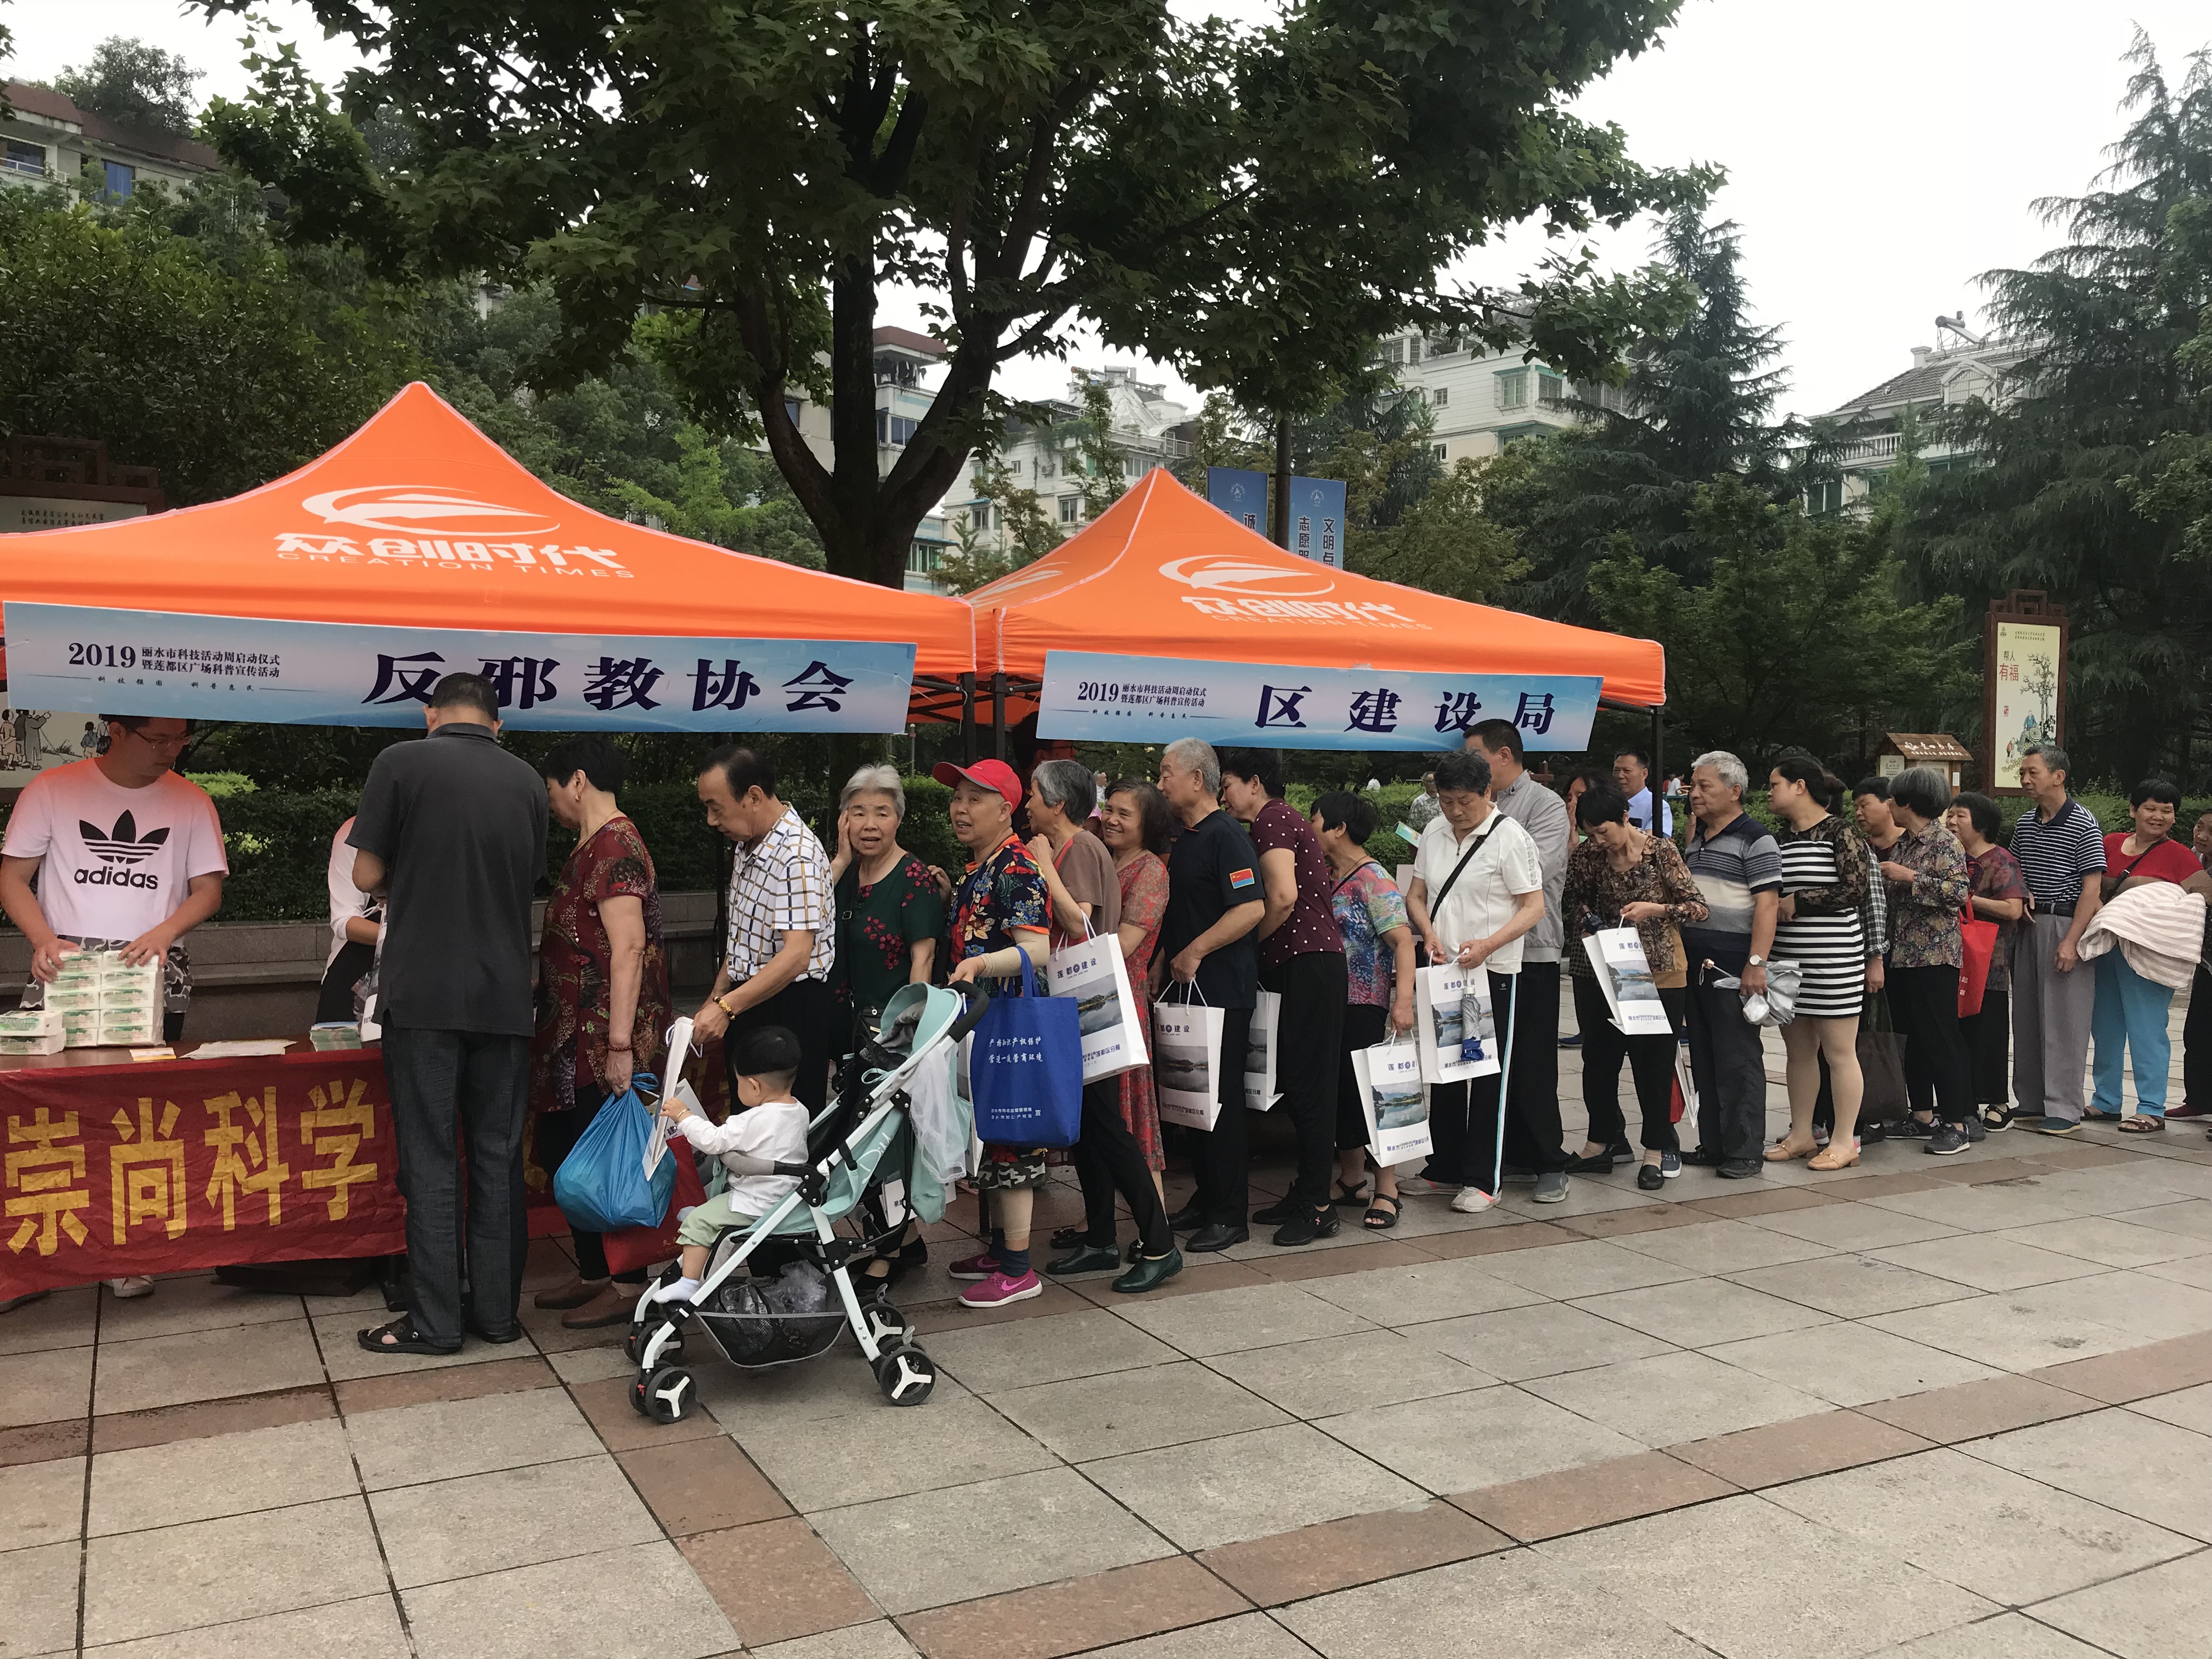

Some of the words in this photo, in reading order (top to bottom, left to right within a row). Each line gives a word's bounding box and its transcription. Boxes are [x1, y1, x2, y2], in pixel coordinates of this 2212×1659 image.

[273, 533, 627, 568] 众创时代
[1323, 518, 1335, 566] 文明点
[278, 553, 493, 571] CREATION
[513, 565, 634, 578] TIMES
[1181, 596, 1417, 622] 众创时代
[1211, 615, 1346, 626] CREATION
[1352, 620, 1433, 630] TIMES
[69, 642, 136, 668] 2019
[142, 647, 280, 665] 丽水市科技活动周启动仪式
[2004, 651, 2015, 661] 帮人
[142, 659, 280, 678] 暨莲都区广场科普宣传活动
[1999, 663, 2019, 681] 有福
[360, 651, 854, 712] 反邪教协会
[1077, 682, 1119, 702] 2019
[1122, 683, 1207, 697] 丽水市科技活动周启动仪式
[1121, 694, 1205, 707] 暨莲都区广场科普宣传活动
[1255, 684, 1555, 735] 区建设局
[74, 866, 158, 890] adidas
[4, 1078, 378, 1257] 崇尚科学
